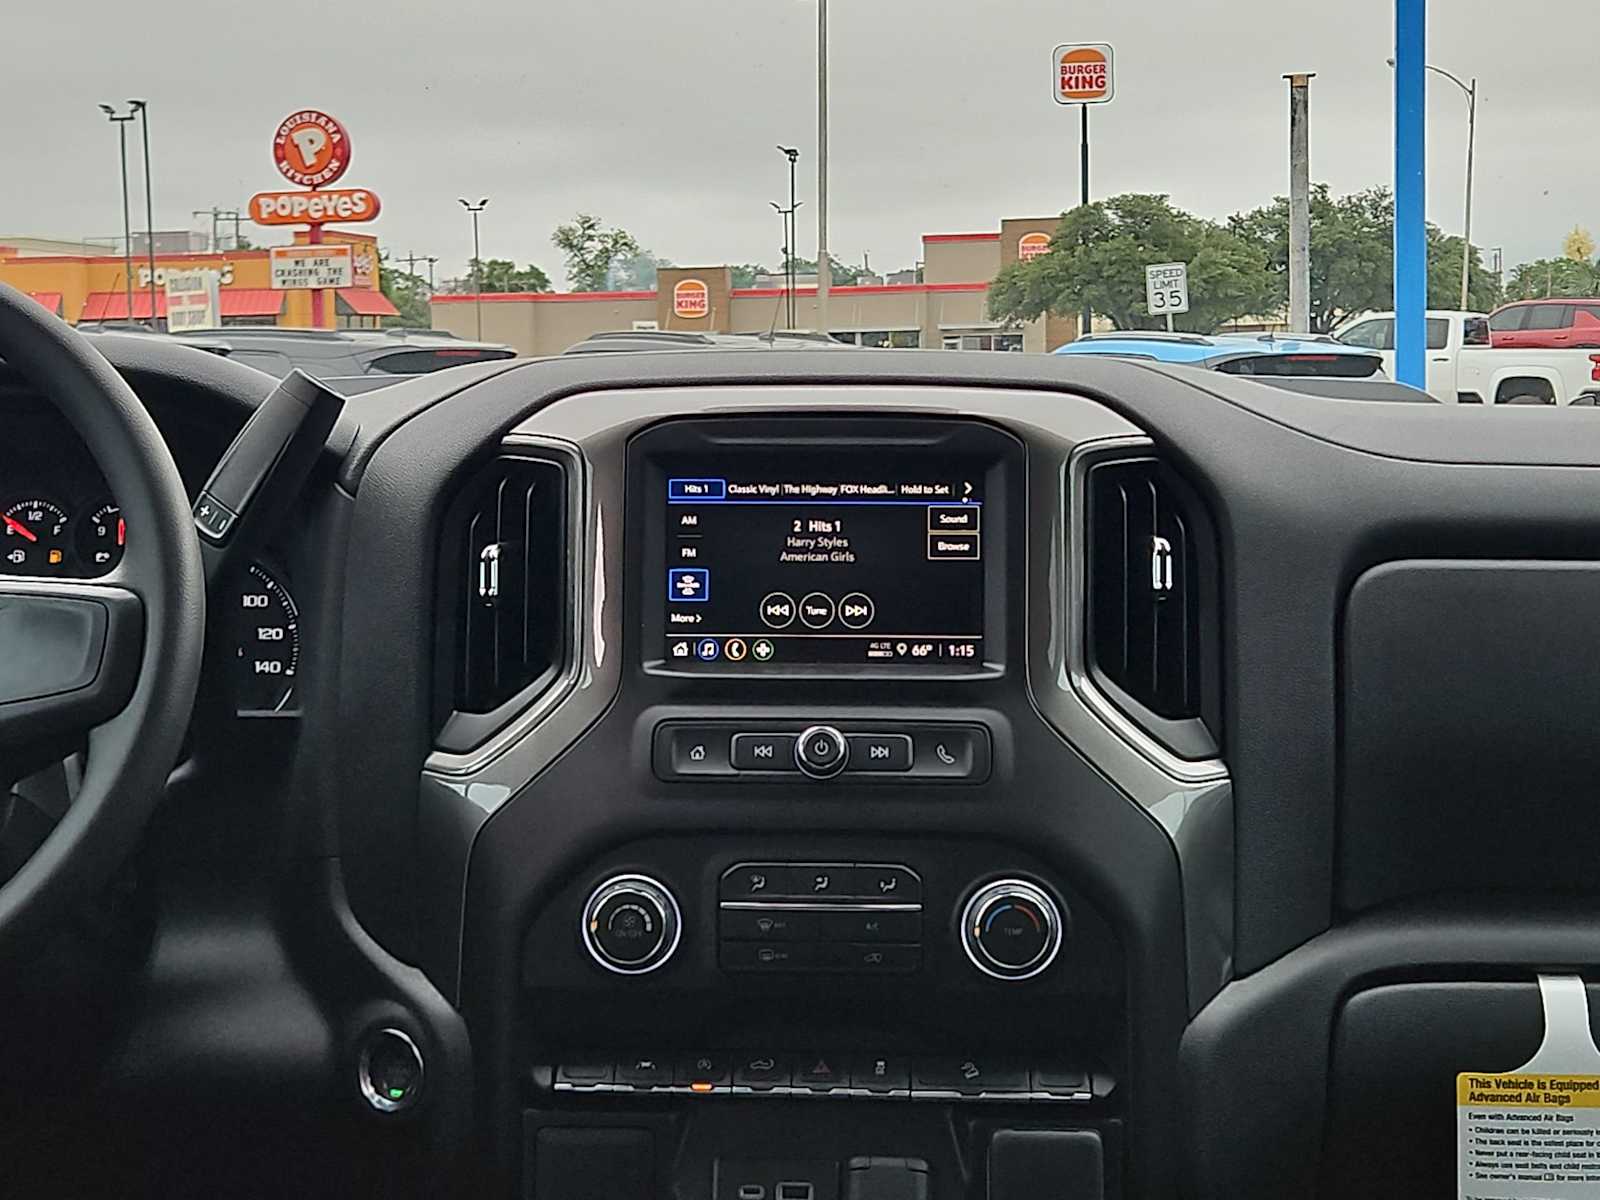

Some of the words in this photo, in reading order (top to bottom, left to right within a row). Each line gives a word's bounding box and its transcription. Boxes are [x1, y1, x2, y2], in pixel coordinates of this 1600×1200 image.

[1060, 64, 1106, 75] BURGER
[1060, 75, 1106, 90] KING
[275, 112, 341, 145] LOUISIANA
[290, 127, 326, 167] P
[279, 158, 341, 185] KITCHEN
[294, 259, 305, 267] WE
[313, 258, 330, 266] ARE
[327, 267, 343, 276] THE
[1149, 268, 1184, 280] SPEED
[317, 277, 340, 285] GAME
[1153, 279, 1179, 290] LIMIT
[676, 299, 705, 309] KING
[1153, 290, 1183, 308] 35
[684, 484, 702, 493] Hits
[728, 484, 758, 494] Classic
[758, 484, 780, 496] Vinyl
[783, 484, 800, 494] The
[801, 484, 838, 496] Highway
[840, 484, 859, 494] FOX
[901, 485, 923, 494] Hold
[923, 485, 933, 494] to
[934, 485, 950, 494] Set
[681, 515, 698, 525] AM
[939, 513, 968, 524] Sound
[53, 524, 61, 536] F
[97, 525, 106, 536] 9
[793, 519, 802, 532] 2
[808, 519, 833, 532] Hits
[834, 519, 841, 532] 1
[787, 536, 816, 550] Harry
[817, 536, 849, 550] Styles
[937, 541, 970, 551] Browse
[681, 547, 697, 558] FM
[780, 551, 829, 562] American
[830, 551, 856, 563] Girls
[242, 594, 269, 608] 100
[805, 604, 828, 616] Tune
[671, 613, 695, 623] More
[257, 627, 284, 640] 120
[948, 644, 975, 657] 1:15
[254, 660, 282, 674] 140
[1468, 1078, 1492, 1088] This
[1494, 1078, 1534, 1090] Vehicle
[1549, 1079, 1600, 1092] Equipped
[1469, 1091, 1522, 1103] Advanced
[1525, 1093, 1541, 1103] Air
[1543, 1093, 1571, 1105] Bags
[1506, 1113, 1542, 1121] Advanced
